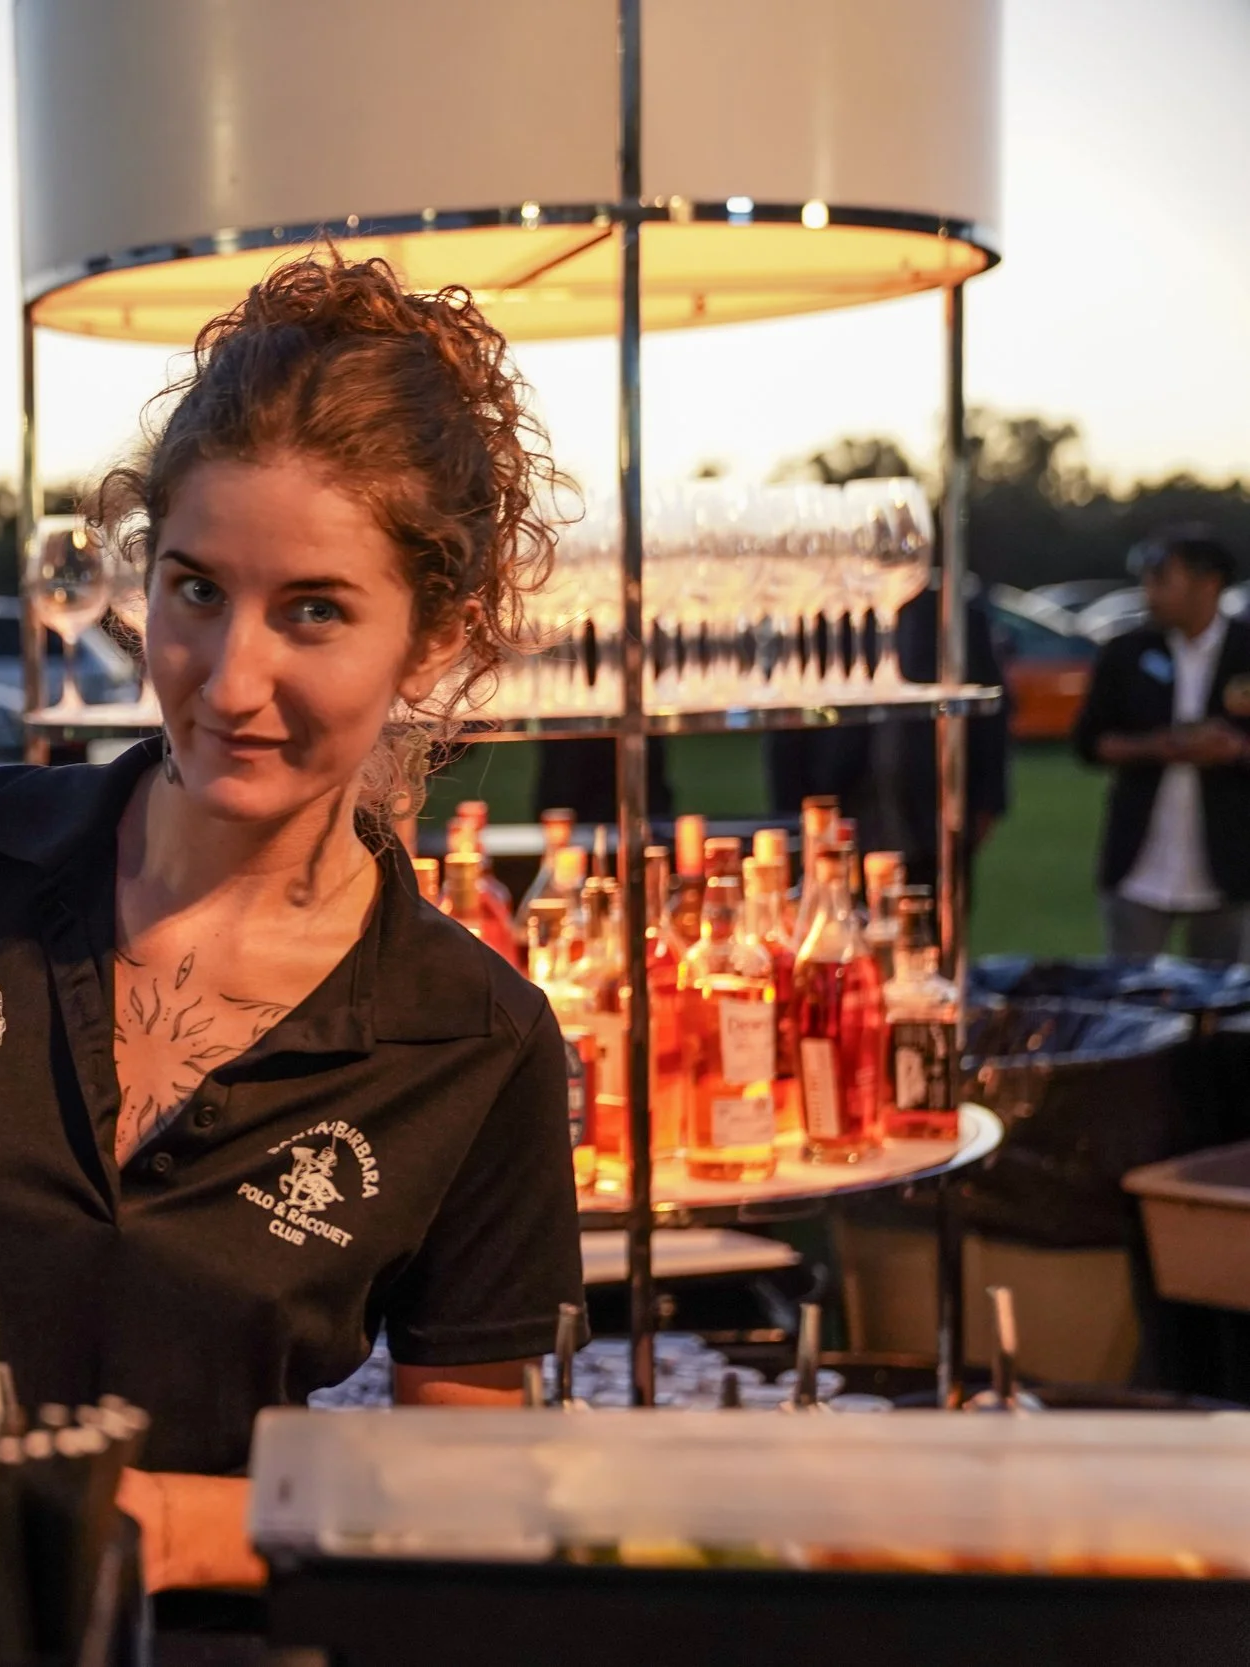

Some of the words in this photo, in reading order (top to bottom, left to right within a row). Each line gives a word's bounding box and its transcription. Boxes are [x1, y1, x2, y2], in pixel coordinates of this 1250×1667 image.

[333, 1120, 379, 1198] BARBARA
[238, 1183, 275, 1210] POLO
[274, 1202, 287, 1217] &
[287, 1208, 353, 1247] RACQUET
[268, 1219, 307, 1246] CLUB
